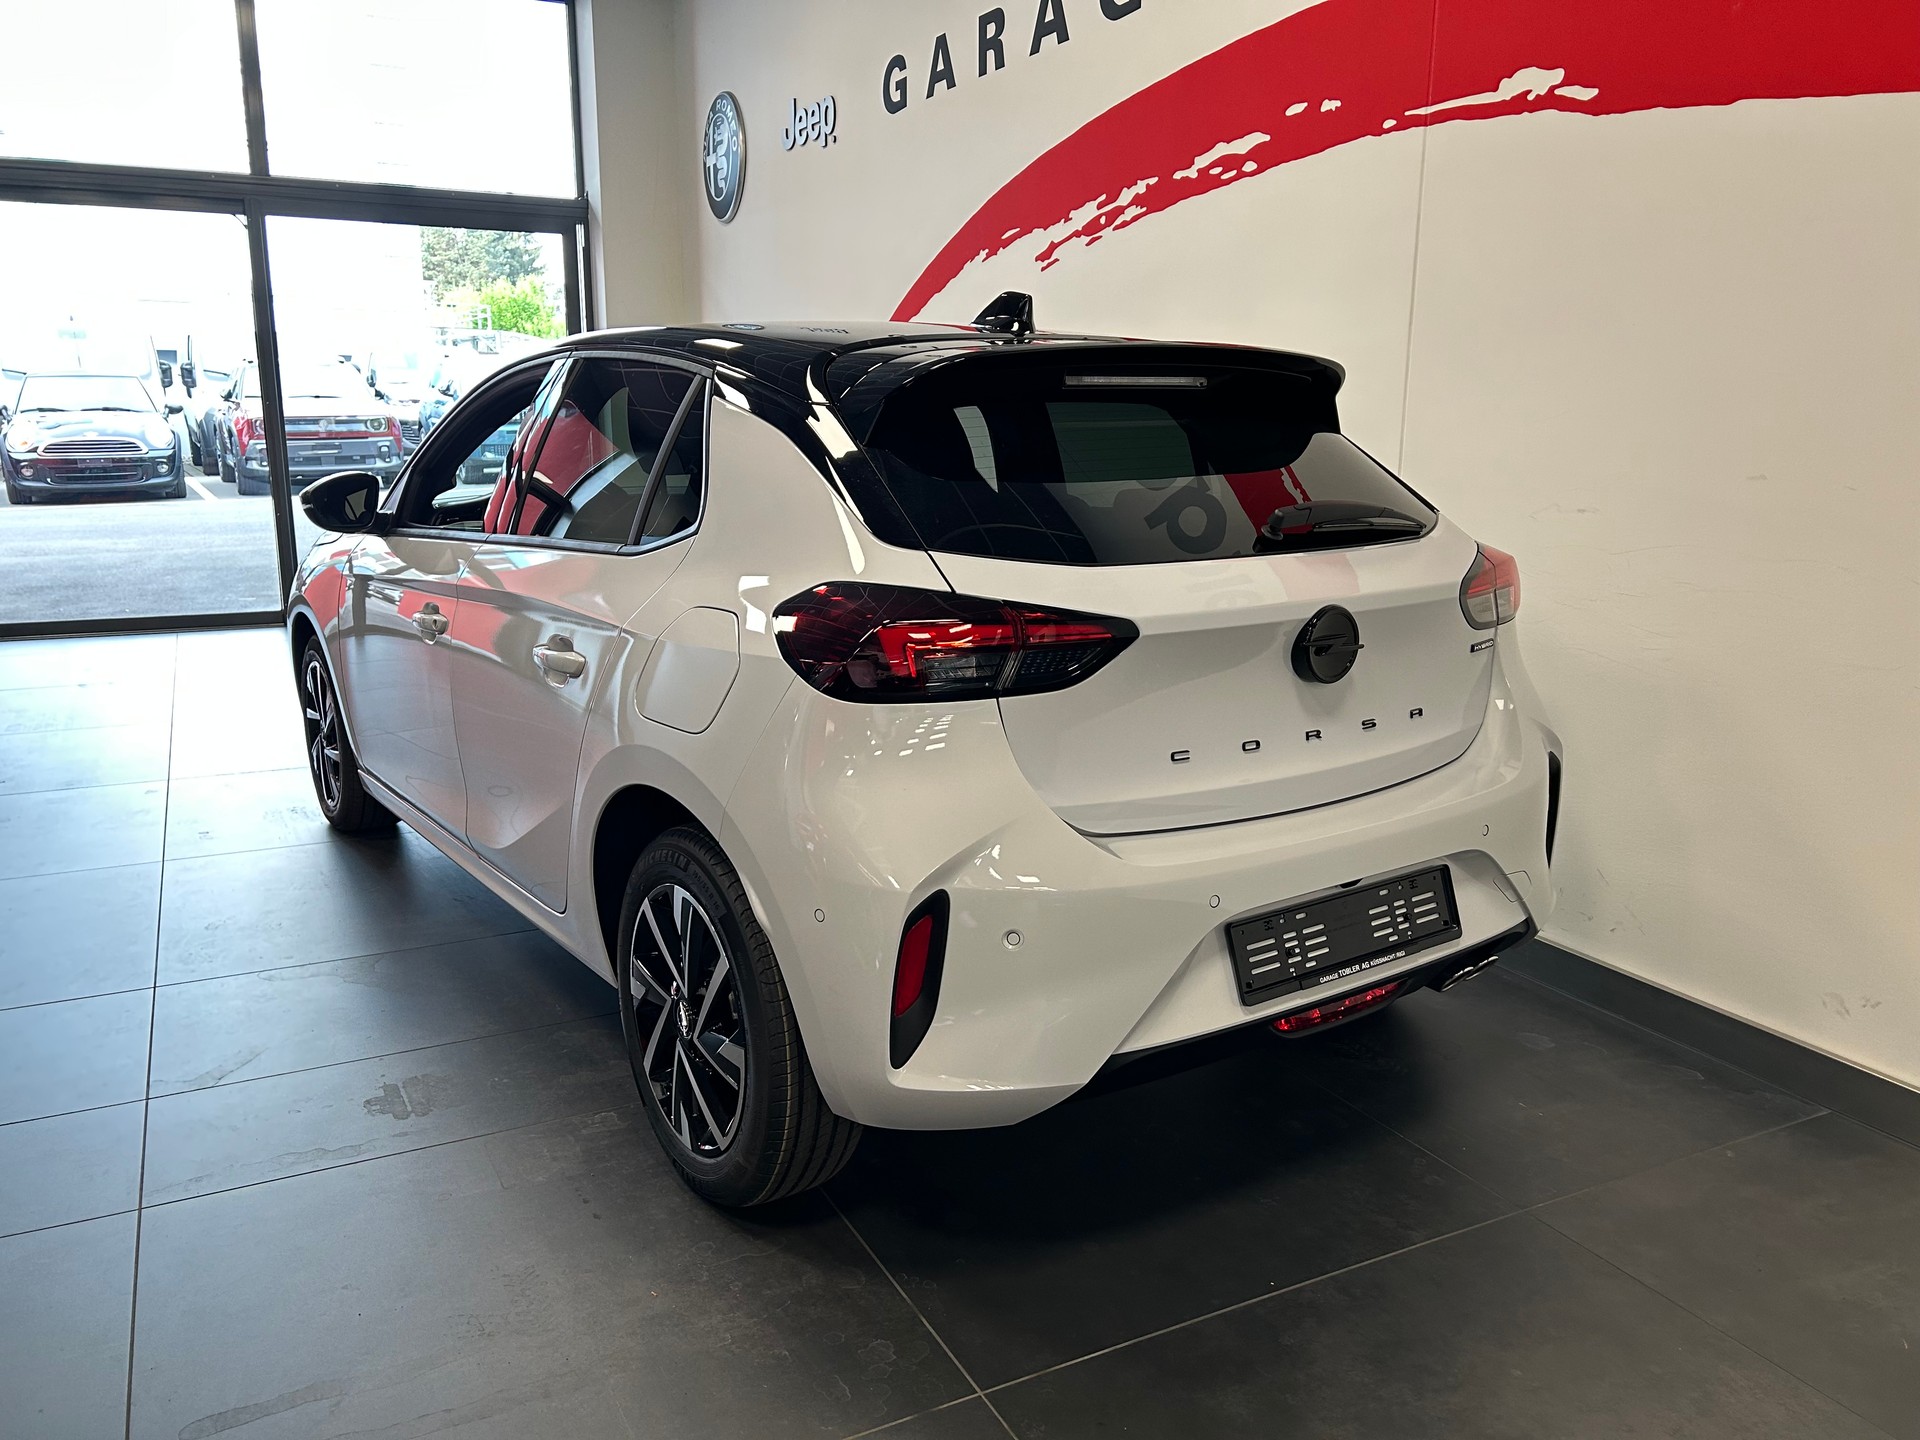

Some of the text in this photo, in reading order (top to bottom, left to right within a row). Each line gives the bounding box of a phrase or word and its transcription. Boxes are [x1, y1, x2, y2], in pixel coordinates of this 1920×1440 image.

[883, 0, 1142, 115] GARA
[715, 99, 738, 152] ROMEO
[781, 95, 836, 151] Jeep
[1171, 707, 1424, 762] CORSA
[638, 849, 689, 872] MICHELIN
[1319, 972, 1339, 984] GARAGE
[1339, 965, 1360, 977] TOBLER
[1361, 961, 1370, 970] AG
